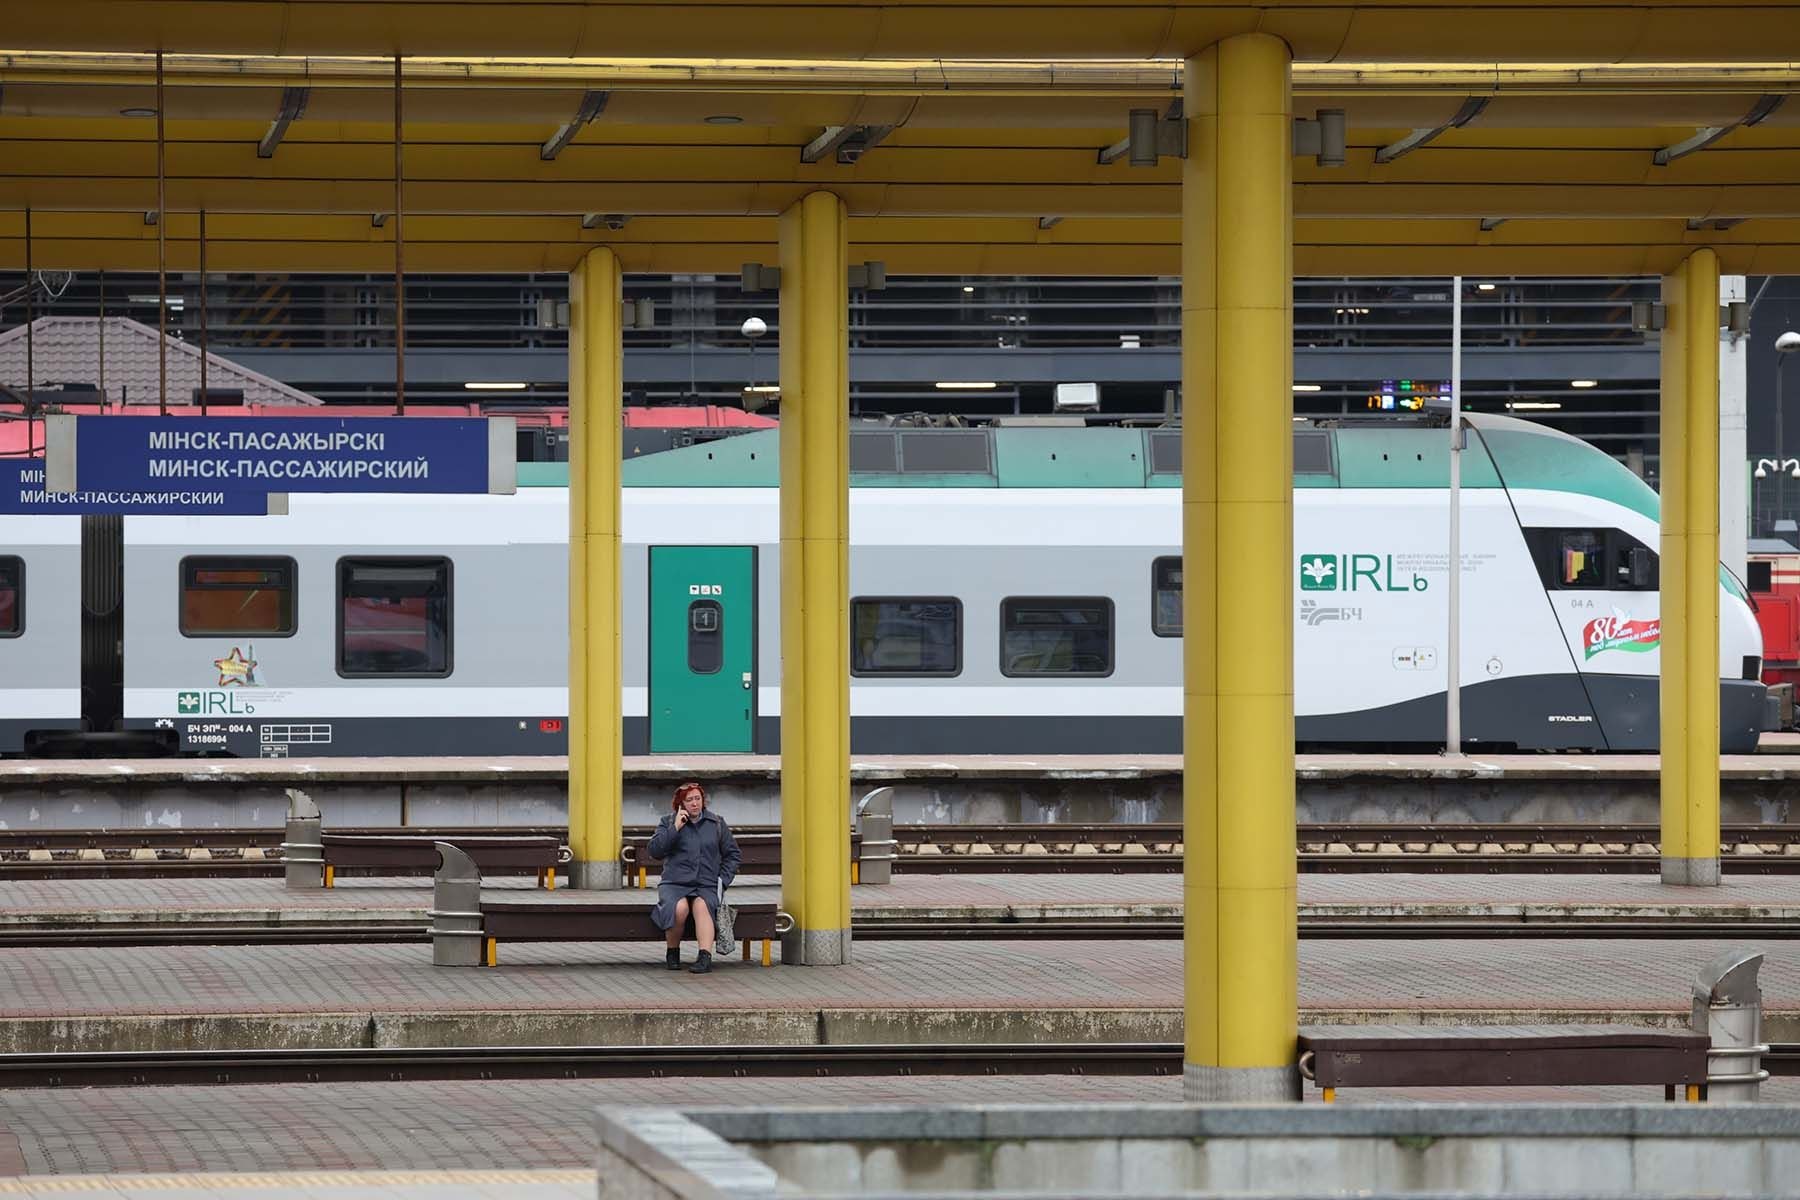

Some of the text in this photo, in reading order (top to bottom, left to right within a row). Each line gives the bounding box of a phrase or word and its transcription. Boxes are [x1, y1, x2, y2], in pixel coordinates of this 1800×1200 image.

[150, 431, 385, 450] МІНСК-ПАСАЖЫРСКІ
[149, 456, 429, 478] МИНСК-ПАССАЖИРСКИЙ
[702, 612, 709, 626] 1
[187, 724, 200, 733] БЧ
